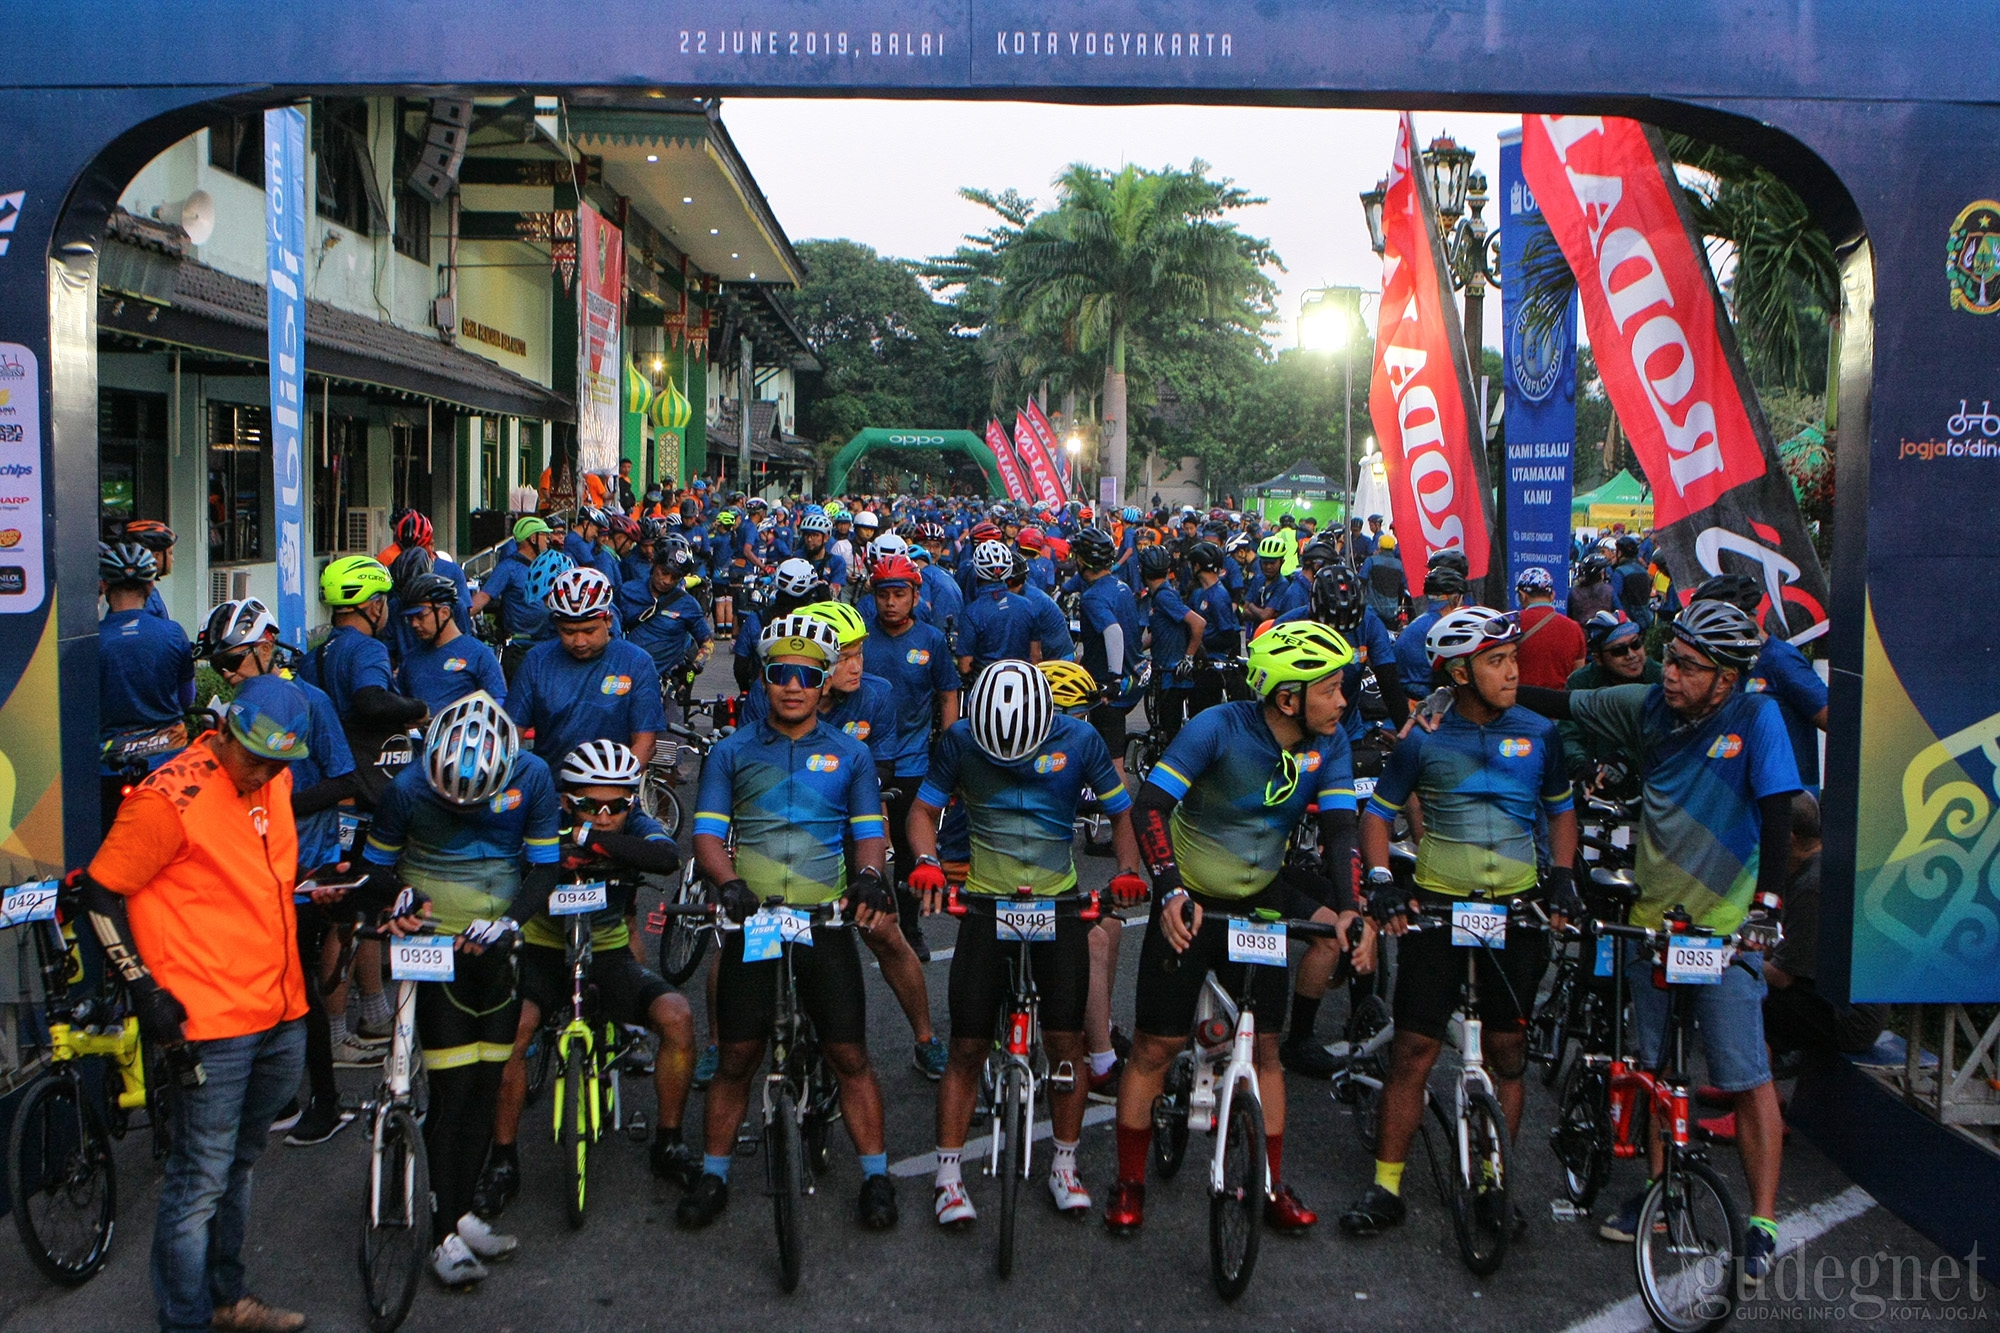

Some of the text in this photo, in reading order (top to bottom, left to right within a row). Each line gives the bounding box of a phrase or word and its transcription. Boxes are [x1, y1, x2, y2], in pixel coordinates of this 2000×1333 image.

[679, 31, 1232, 58] 22 JUNE 2019, BALAI KOTA YOGYAKARTA
[1514, 350, 1561, 395] SATISFACTION
[888, 435, 945, 446] oppo
[1508, 442, 1569, 459] KAMI SELALU
[1898, 438, 2000, 460] jogjafoldin
[1512, 466, 1565, 481] UTAMAKAN
[1523, 489, 1552, 505] KAMU
[1272, 632, 1308, 647] MET
[8, 892, 44, 910] 0421
[557, 891, 597, 903] 0942
[1005, 912, 1046, 926] 0940
[1461, 914, 1498, 930] 0937
[1236, 933, 1277, 950] 0938
[400, 948, 443, 964] 0939
[1676, 949, 1714, 967] 0935
